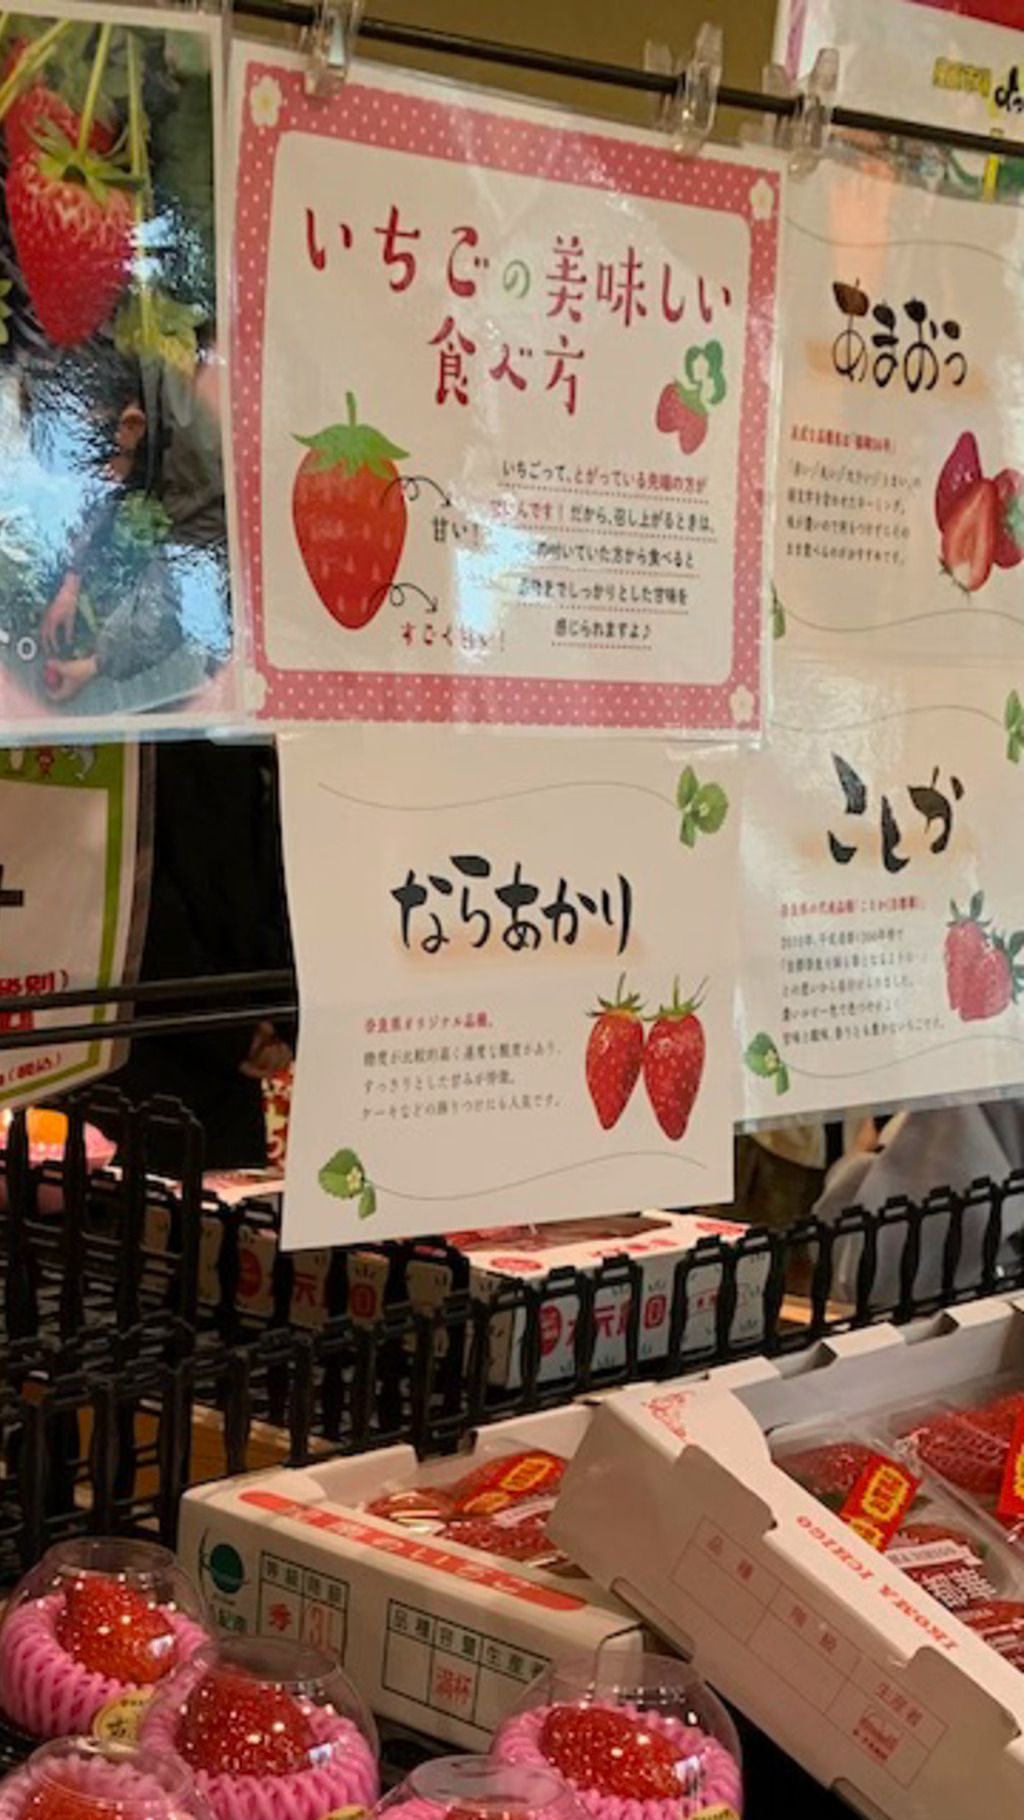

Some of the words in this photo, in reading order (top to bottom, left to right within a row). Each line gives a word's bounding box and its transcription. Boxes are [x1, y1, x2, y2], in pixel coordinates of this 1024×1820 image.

[304, 205, 733, 329] いちごの美味しい
[427, 316, 586, 416] 食べ方
[390, 854, 633, 956] ならあかり
[796, 1515, 875, 1581] ICHIGO
[879, 1582, 959, 1651] IKOMA
